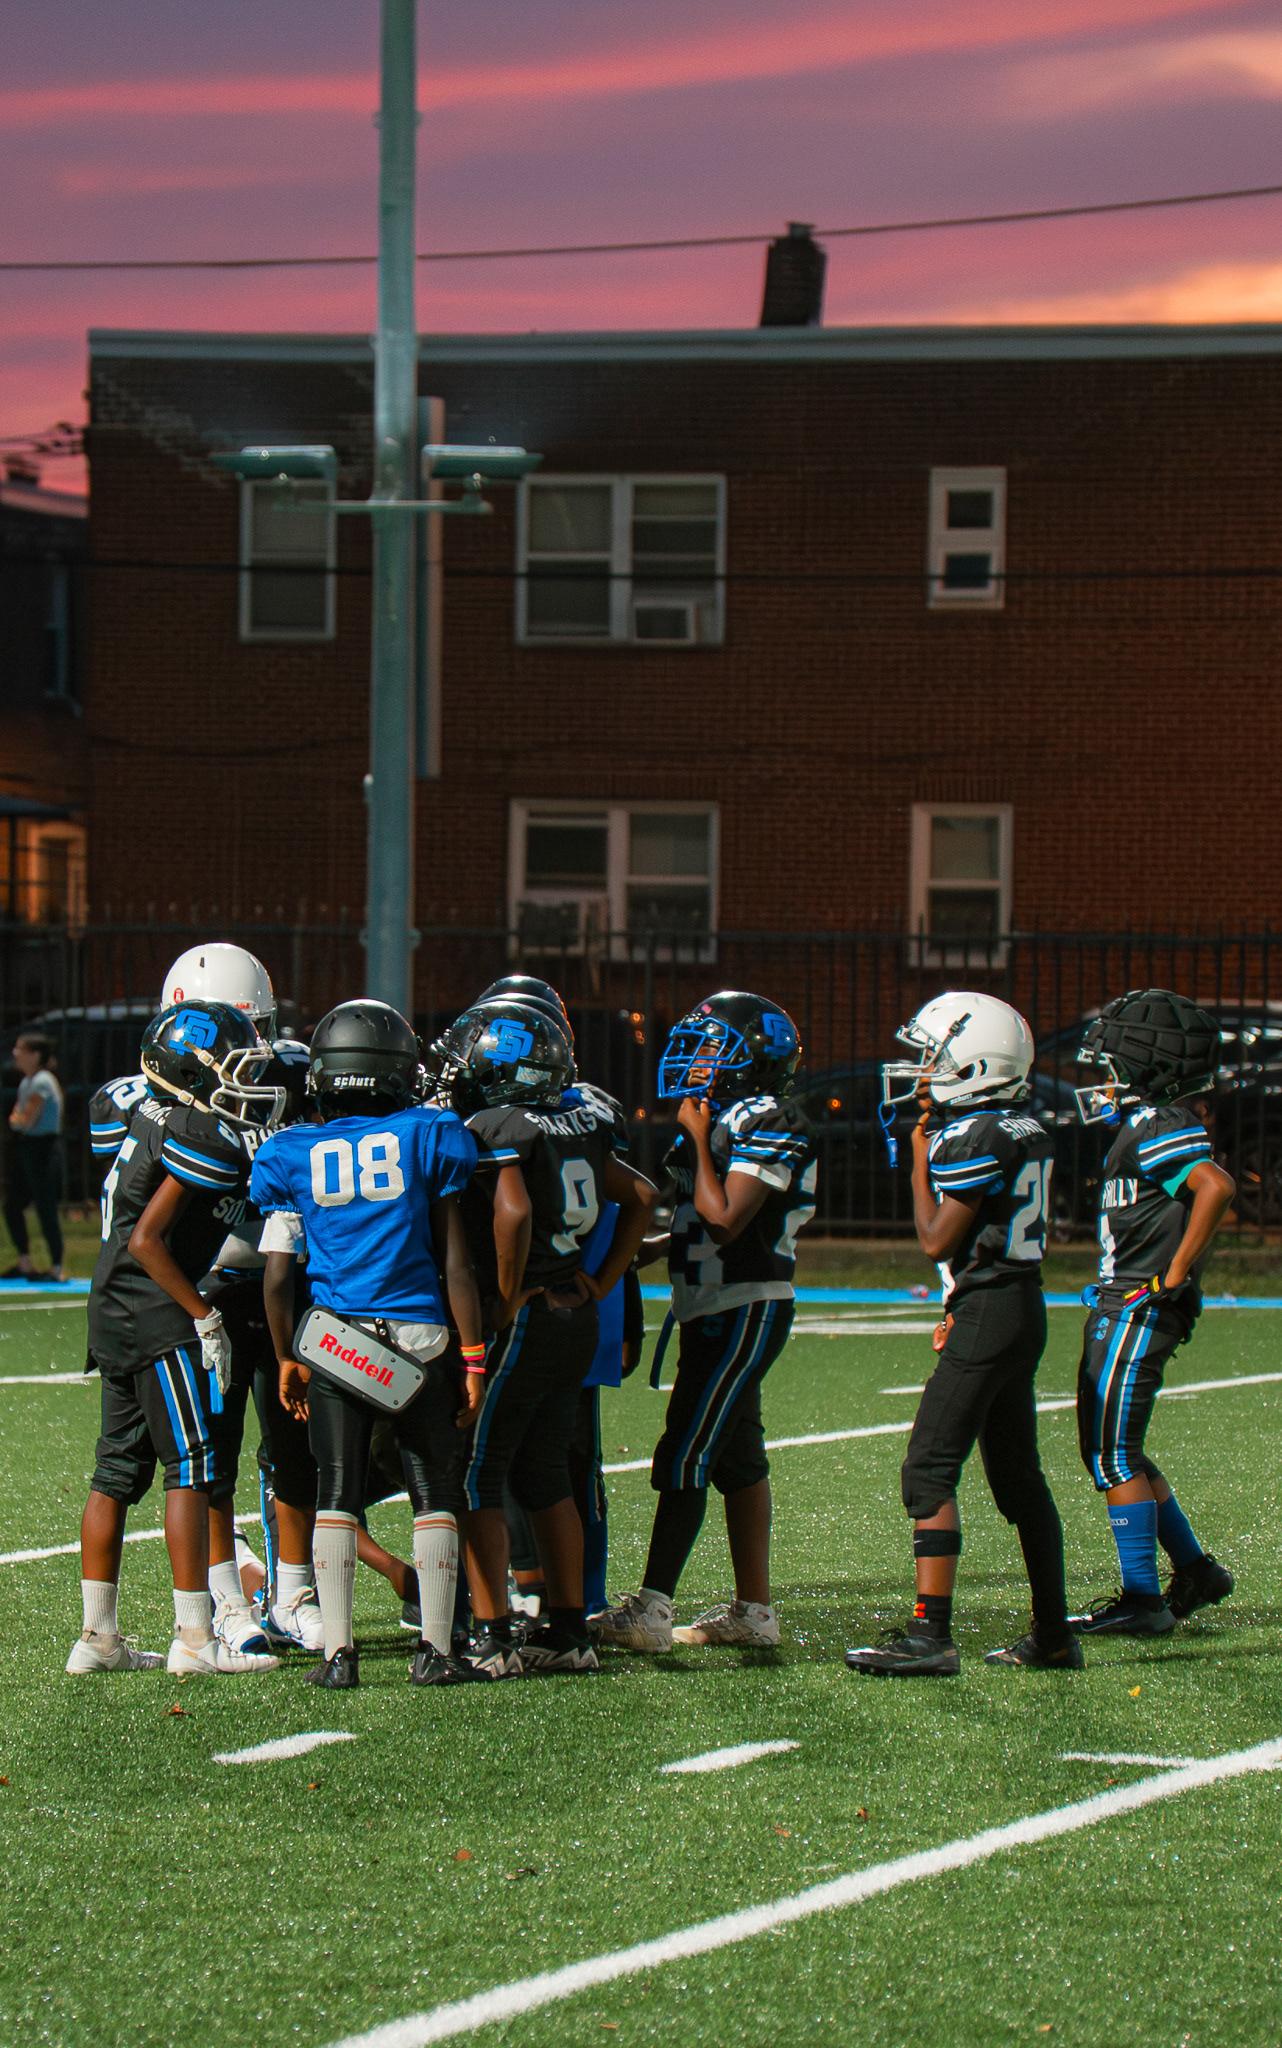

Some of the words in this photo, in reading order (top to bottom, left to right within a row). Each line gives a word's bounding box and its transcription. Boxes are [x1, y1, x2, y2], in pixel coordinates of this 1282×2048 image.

[310, 1131, 406, 1207] 08
[551, 1156, 600, 1257] 9
[318, 1332, 396, 1388] Riddell
